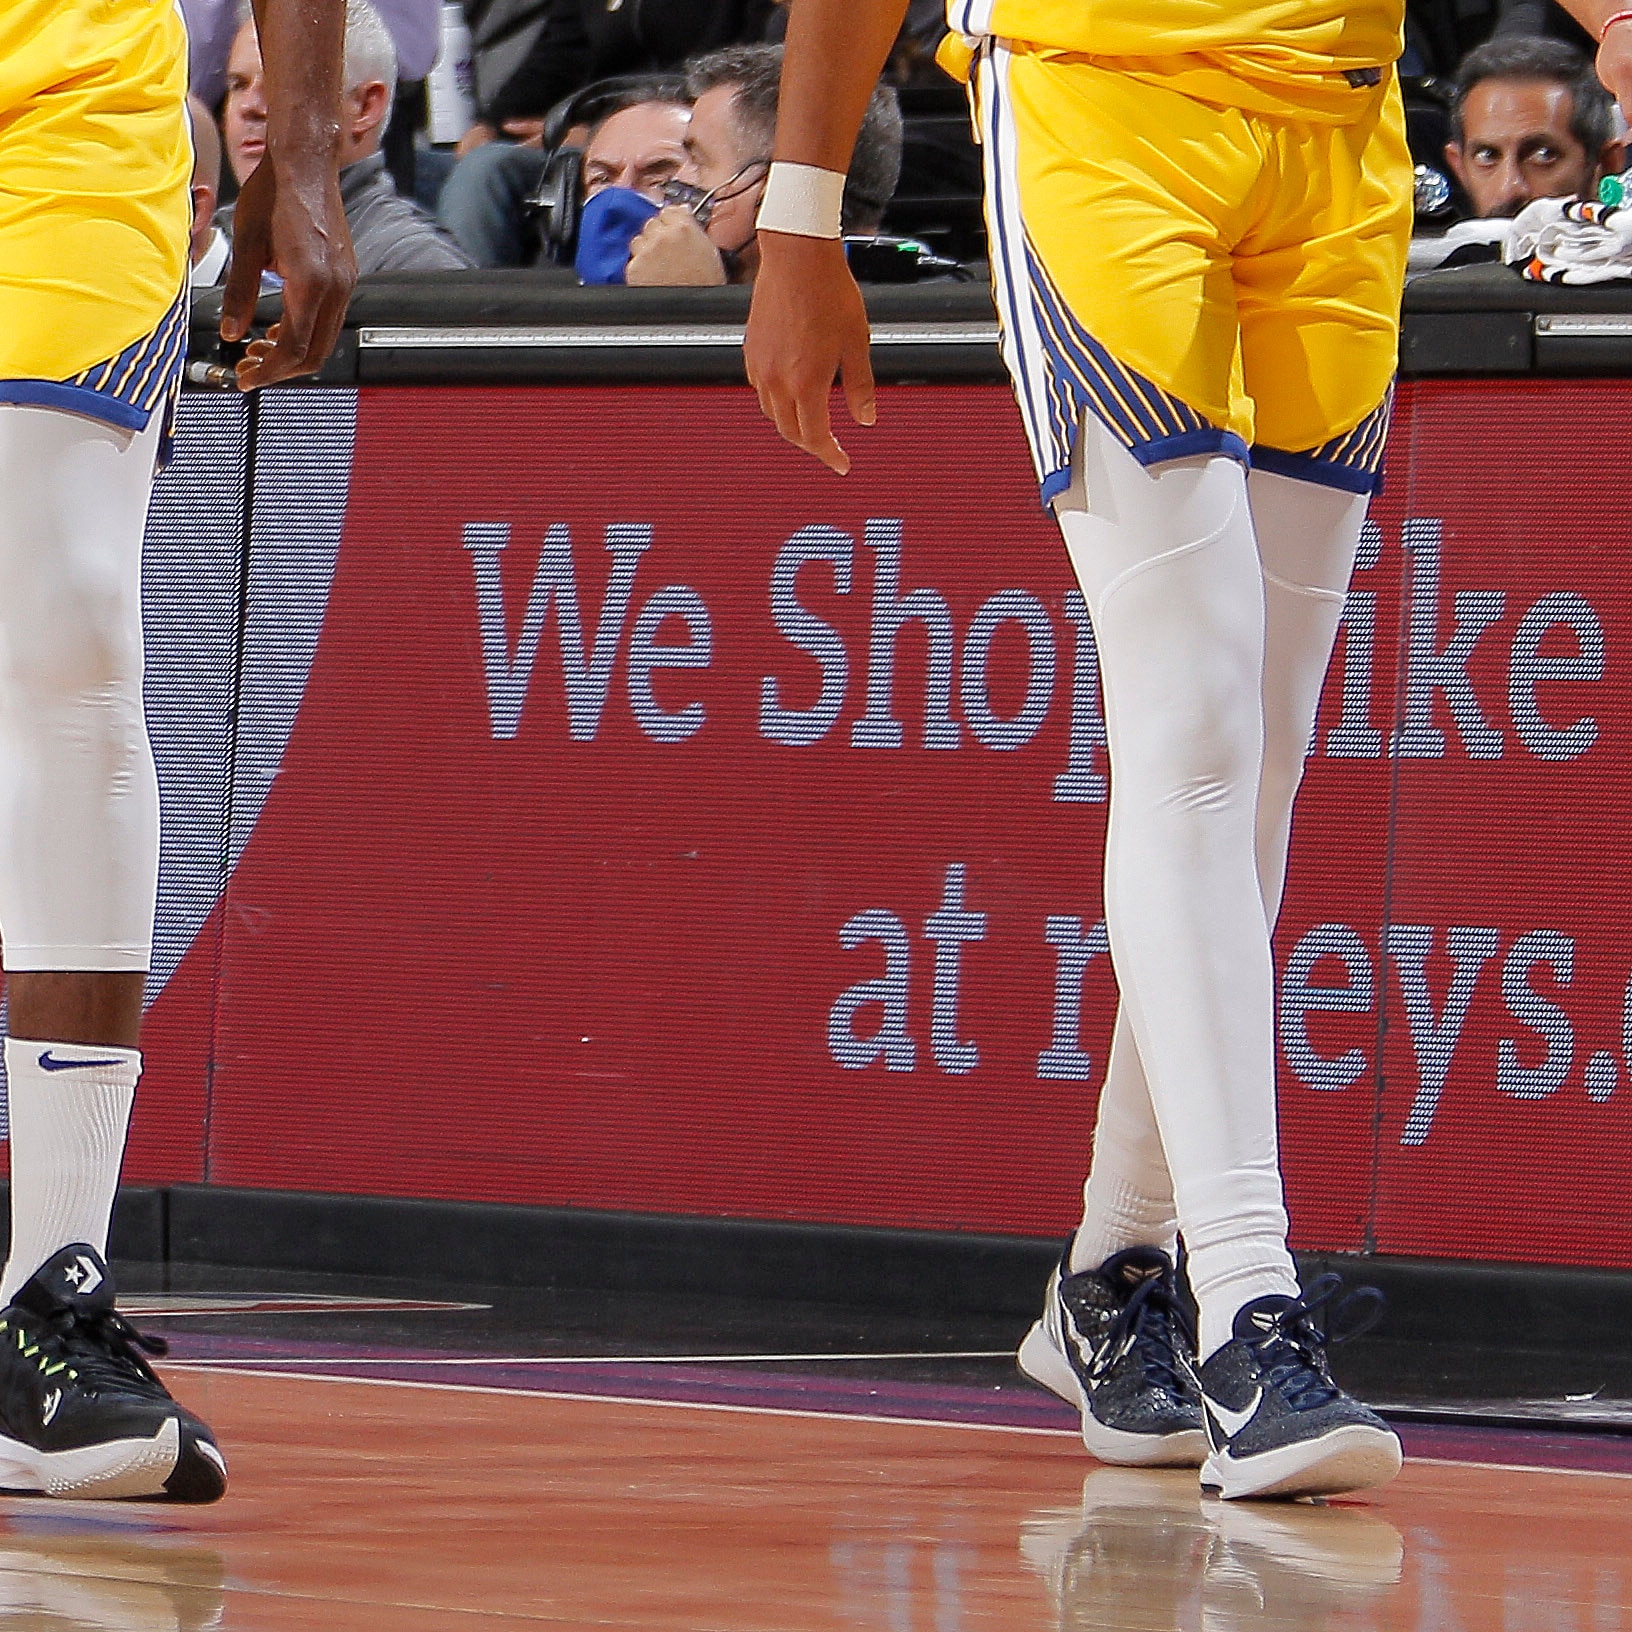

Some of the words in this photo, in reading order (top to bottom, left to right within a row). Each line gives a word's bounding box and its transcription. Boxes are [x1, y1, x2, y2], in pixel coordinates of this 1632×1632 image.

[460, 521, 714, 743] We
[1304, 517, 1605, 762] ike
[826, 861, 988, 1076] at
